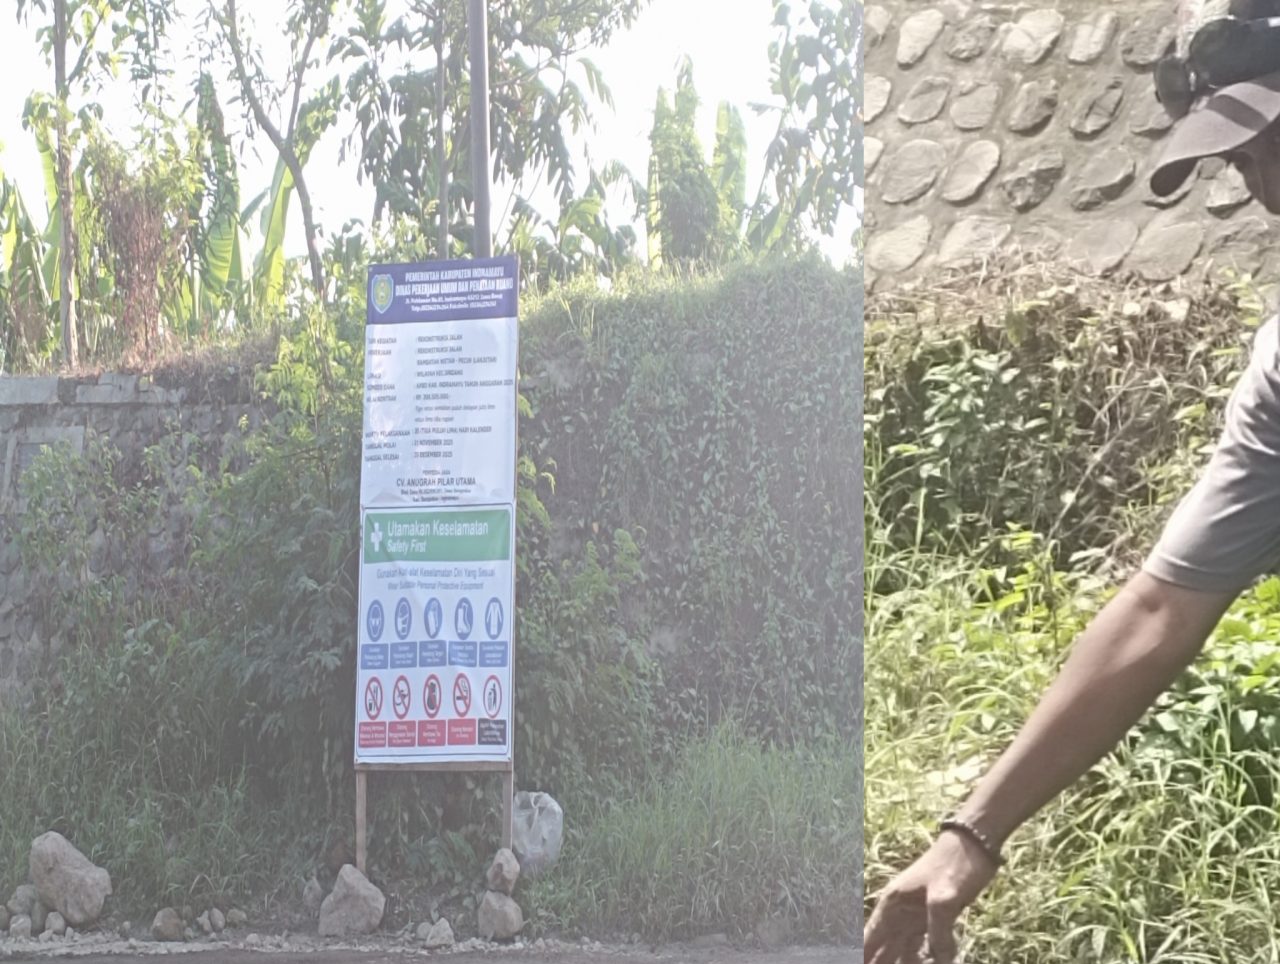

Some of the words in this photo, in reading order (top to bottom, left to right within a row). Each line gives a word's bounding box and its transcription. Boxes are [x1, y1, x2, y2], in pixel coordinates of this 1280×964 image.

[407, 477, 436, 487] ANUGRAH
[437, 476, 455, 486] PILAR
[455, 476, 476, 485] UTAMA
[387, 520, 431, 537] Utamakan
[432, 519, 489, 536] Keselamatan
[387, 540, 409, 555] Safety
[410, 539, 427, 553] First
